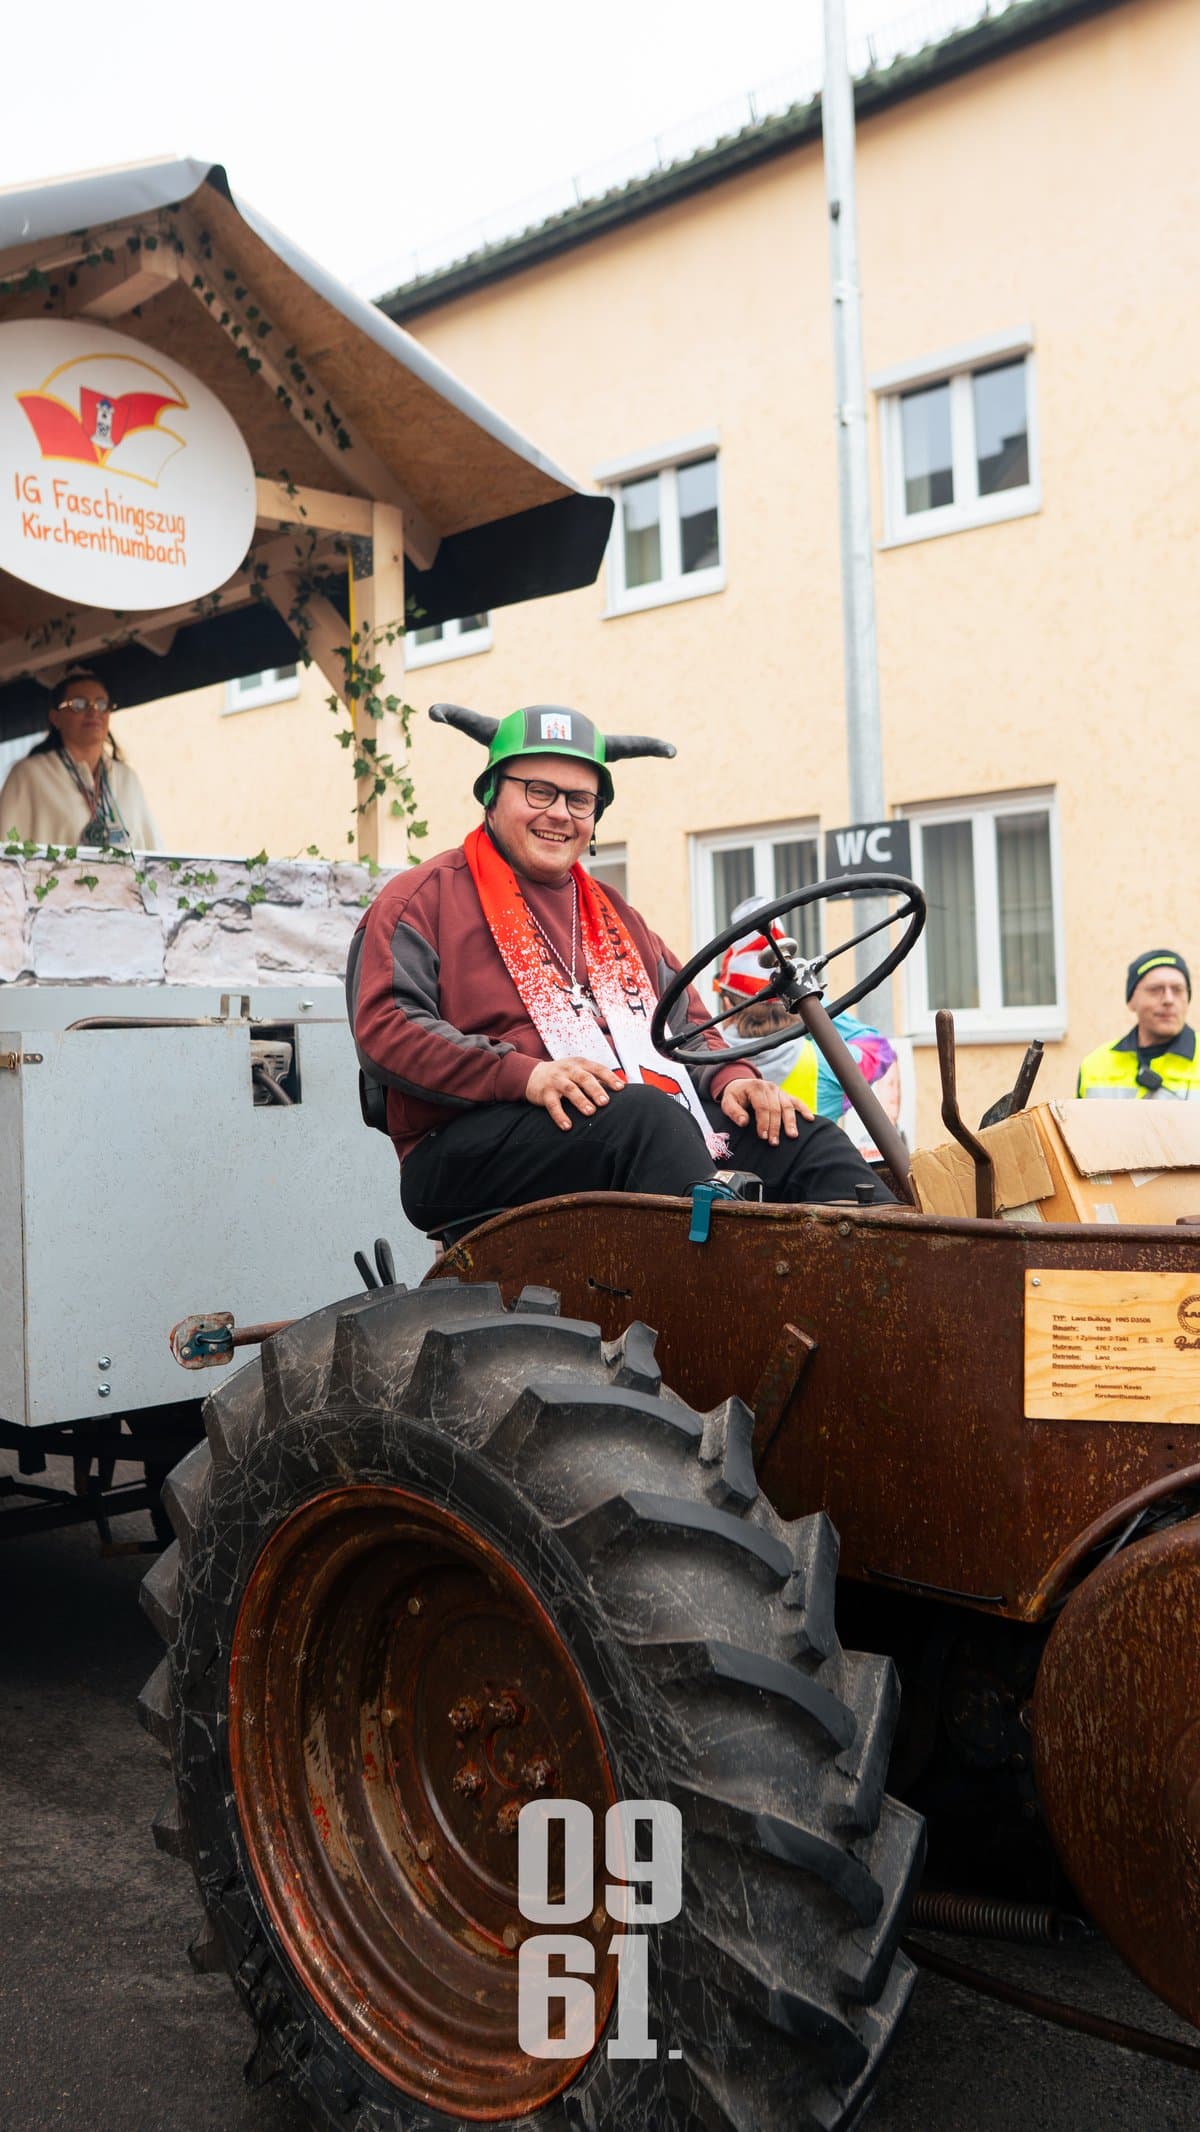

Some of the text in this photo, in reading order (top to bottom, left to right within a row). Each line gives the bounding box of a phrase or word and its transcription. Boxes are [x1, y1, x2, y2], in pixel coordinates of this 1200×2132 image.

[15, 472, 186, 543] IG Faschingszug
[22, 512, 187, 568] Kirchenthumbach
[836, 827, 892, 867] WC
[1094, 1393, 1151, 1401] Kirchenthumbach
